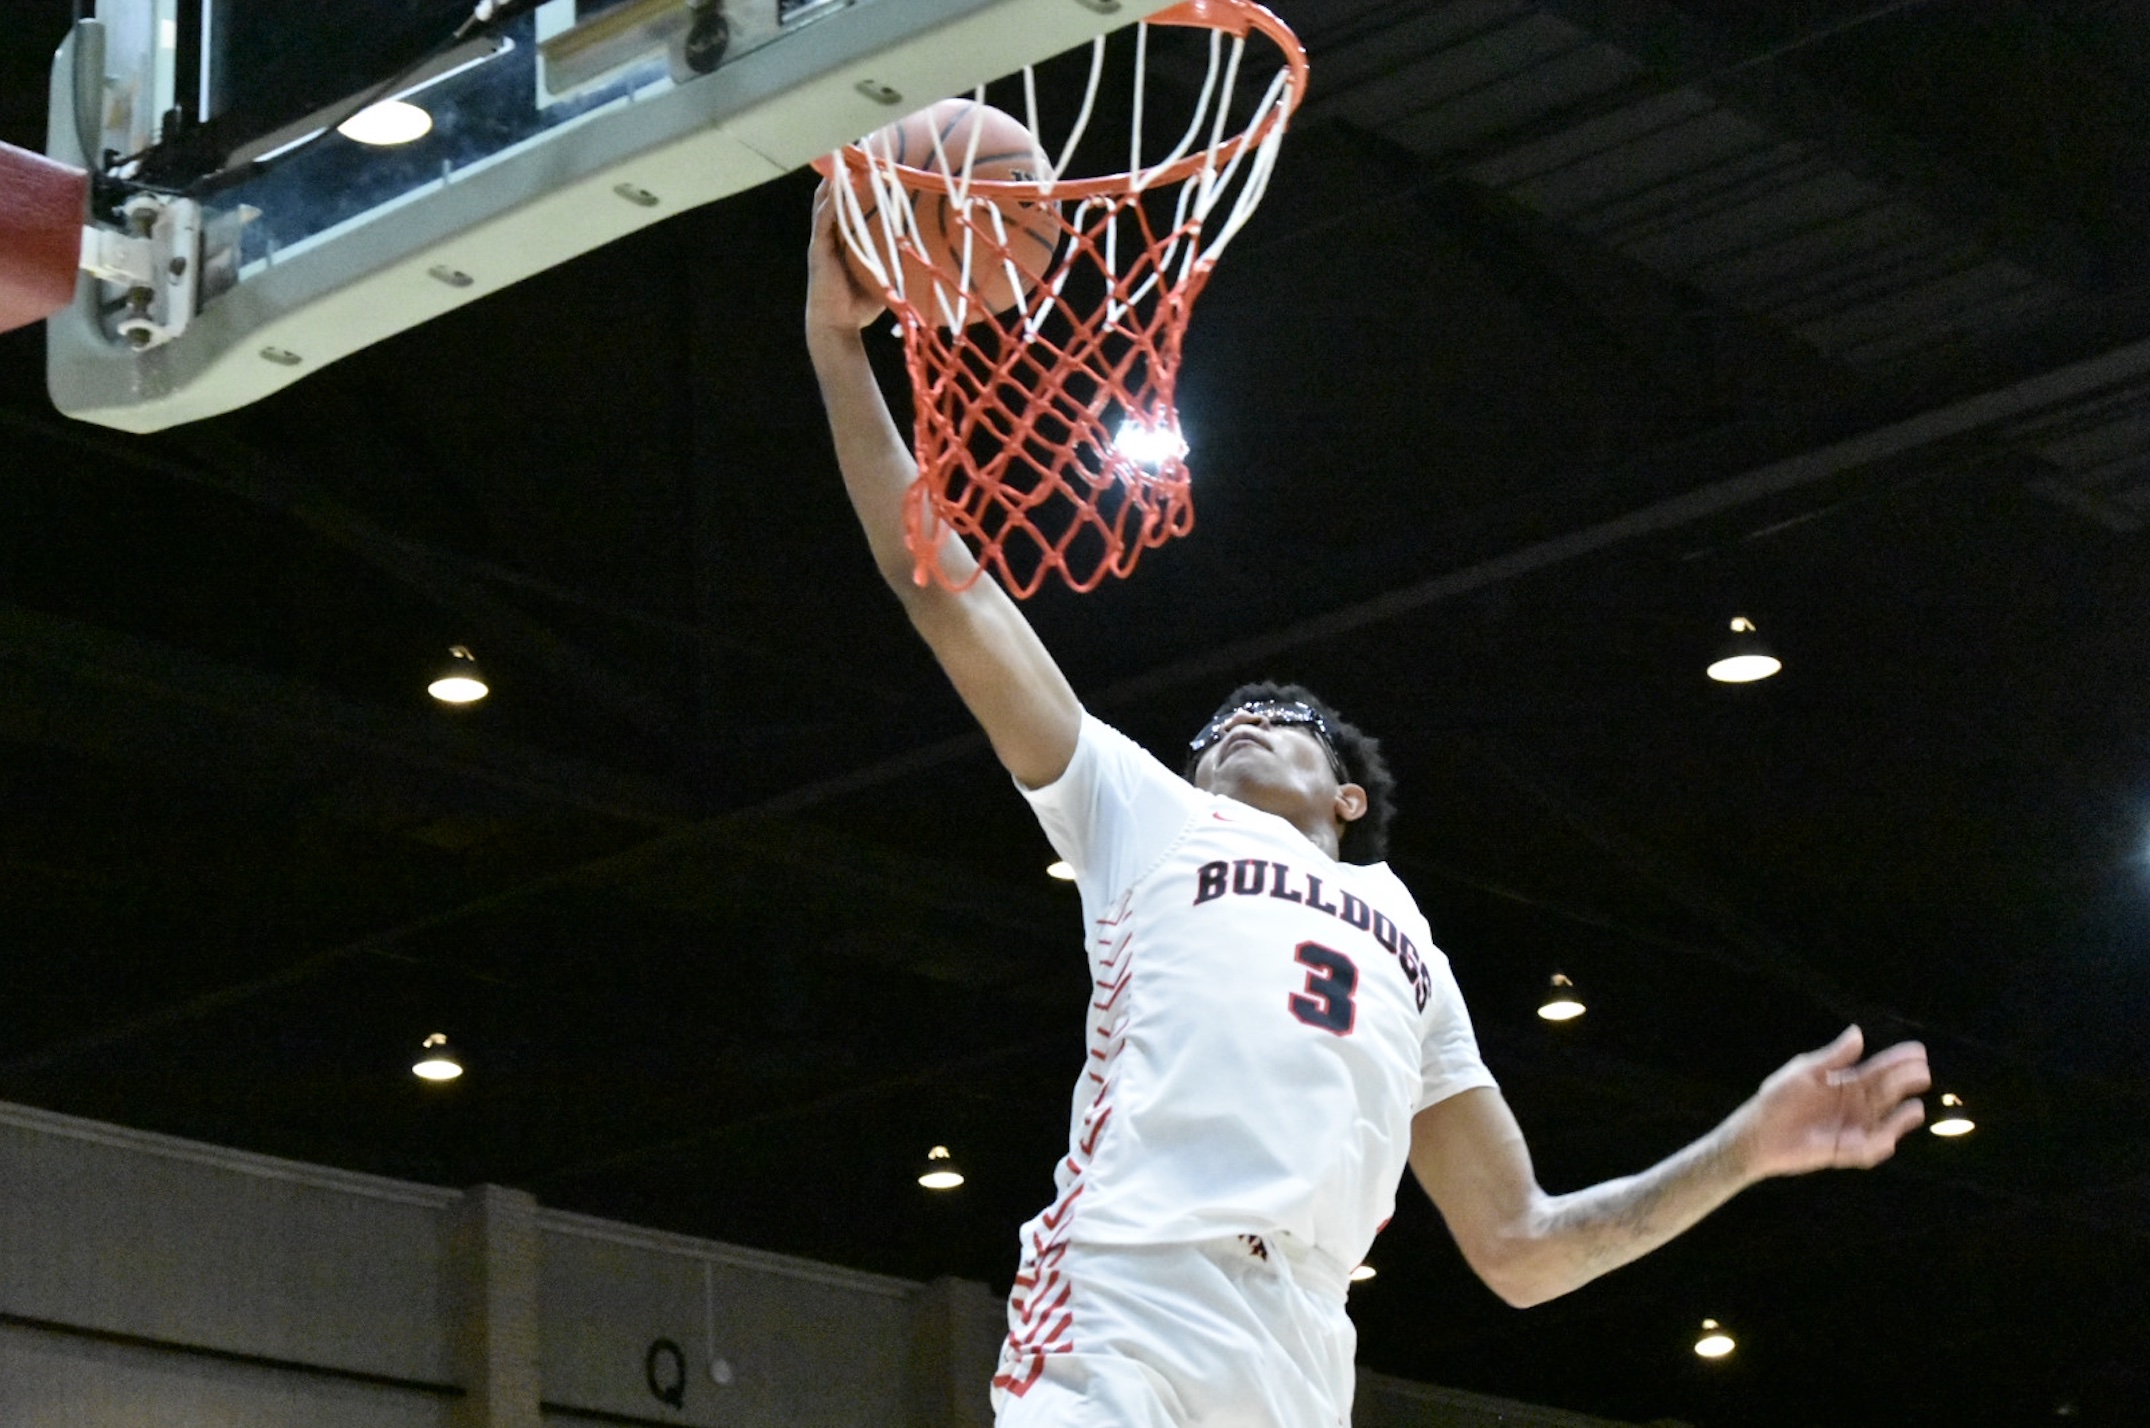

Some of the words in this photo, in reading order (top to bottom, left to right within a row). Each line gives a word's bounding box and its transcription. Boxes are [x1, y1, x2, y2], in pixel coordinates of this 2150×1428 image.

[1194, 860, 1431, 1014] BULLDOGS
[1289, 941, 1358, 1036] 3
[647, 1336, 685, 1409] Q
